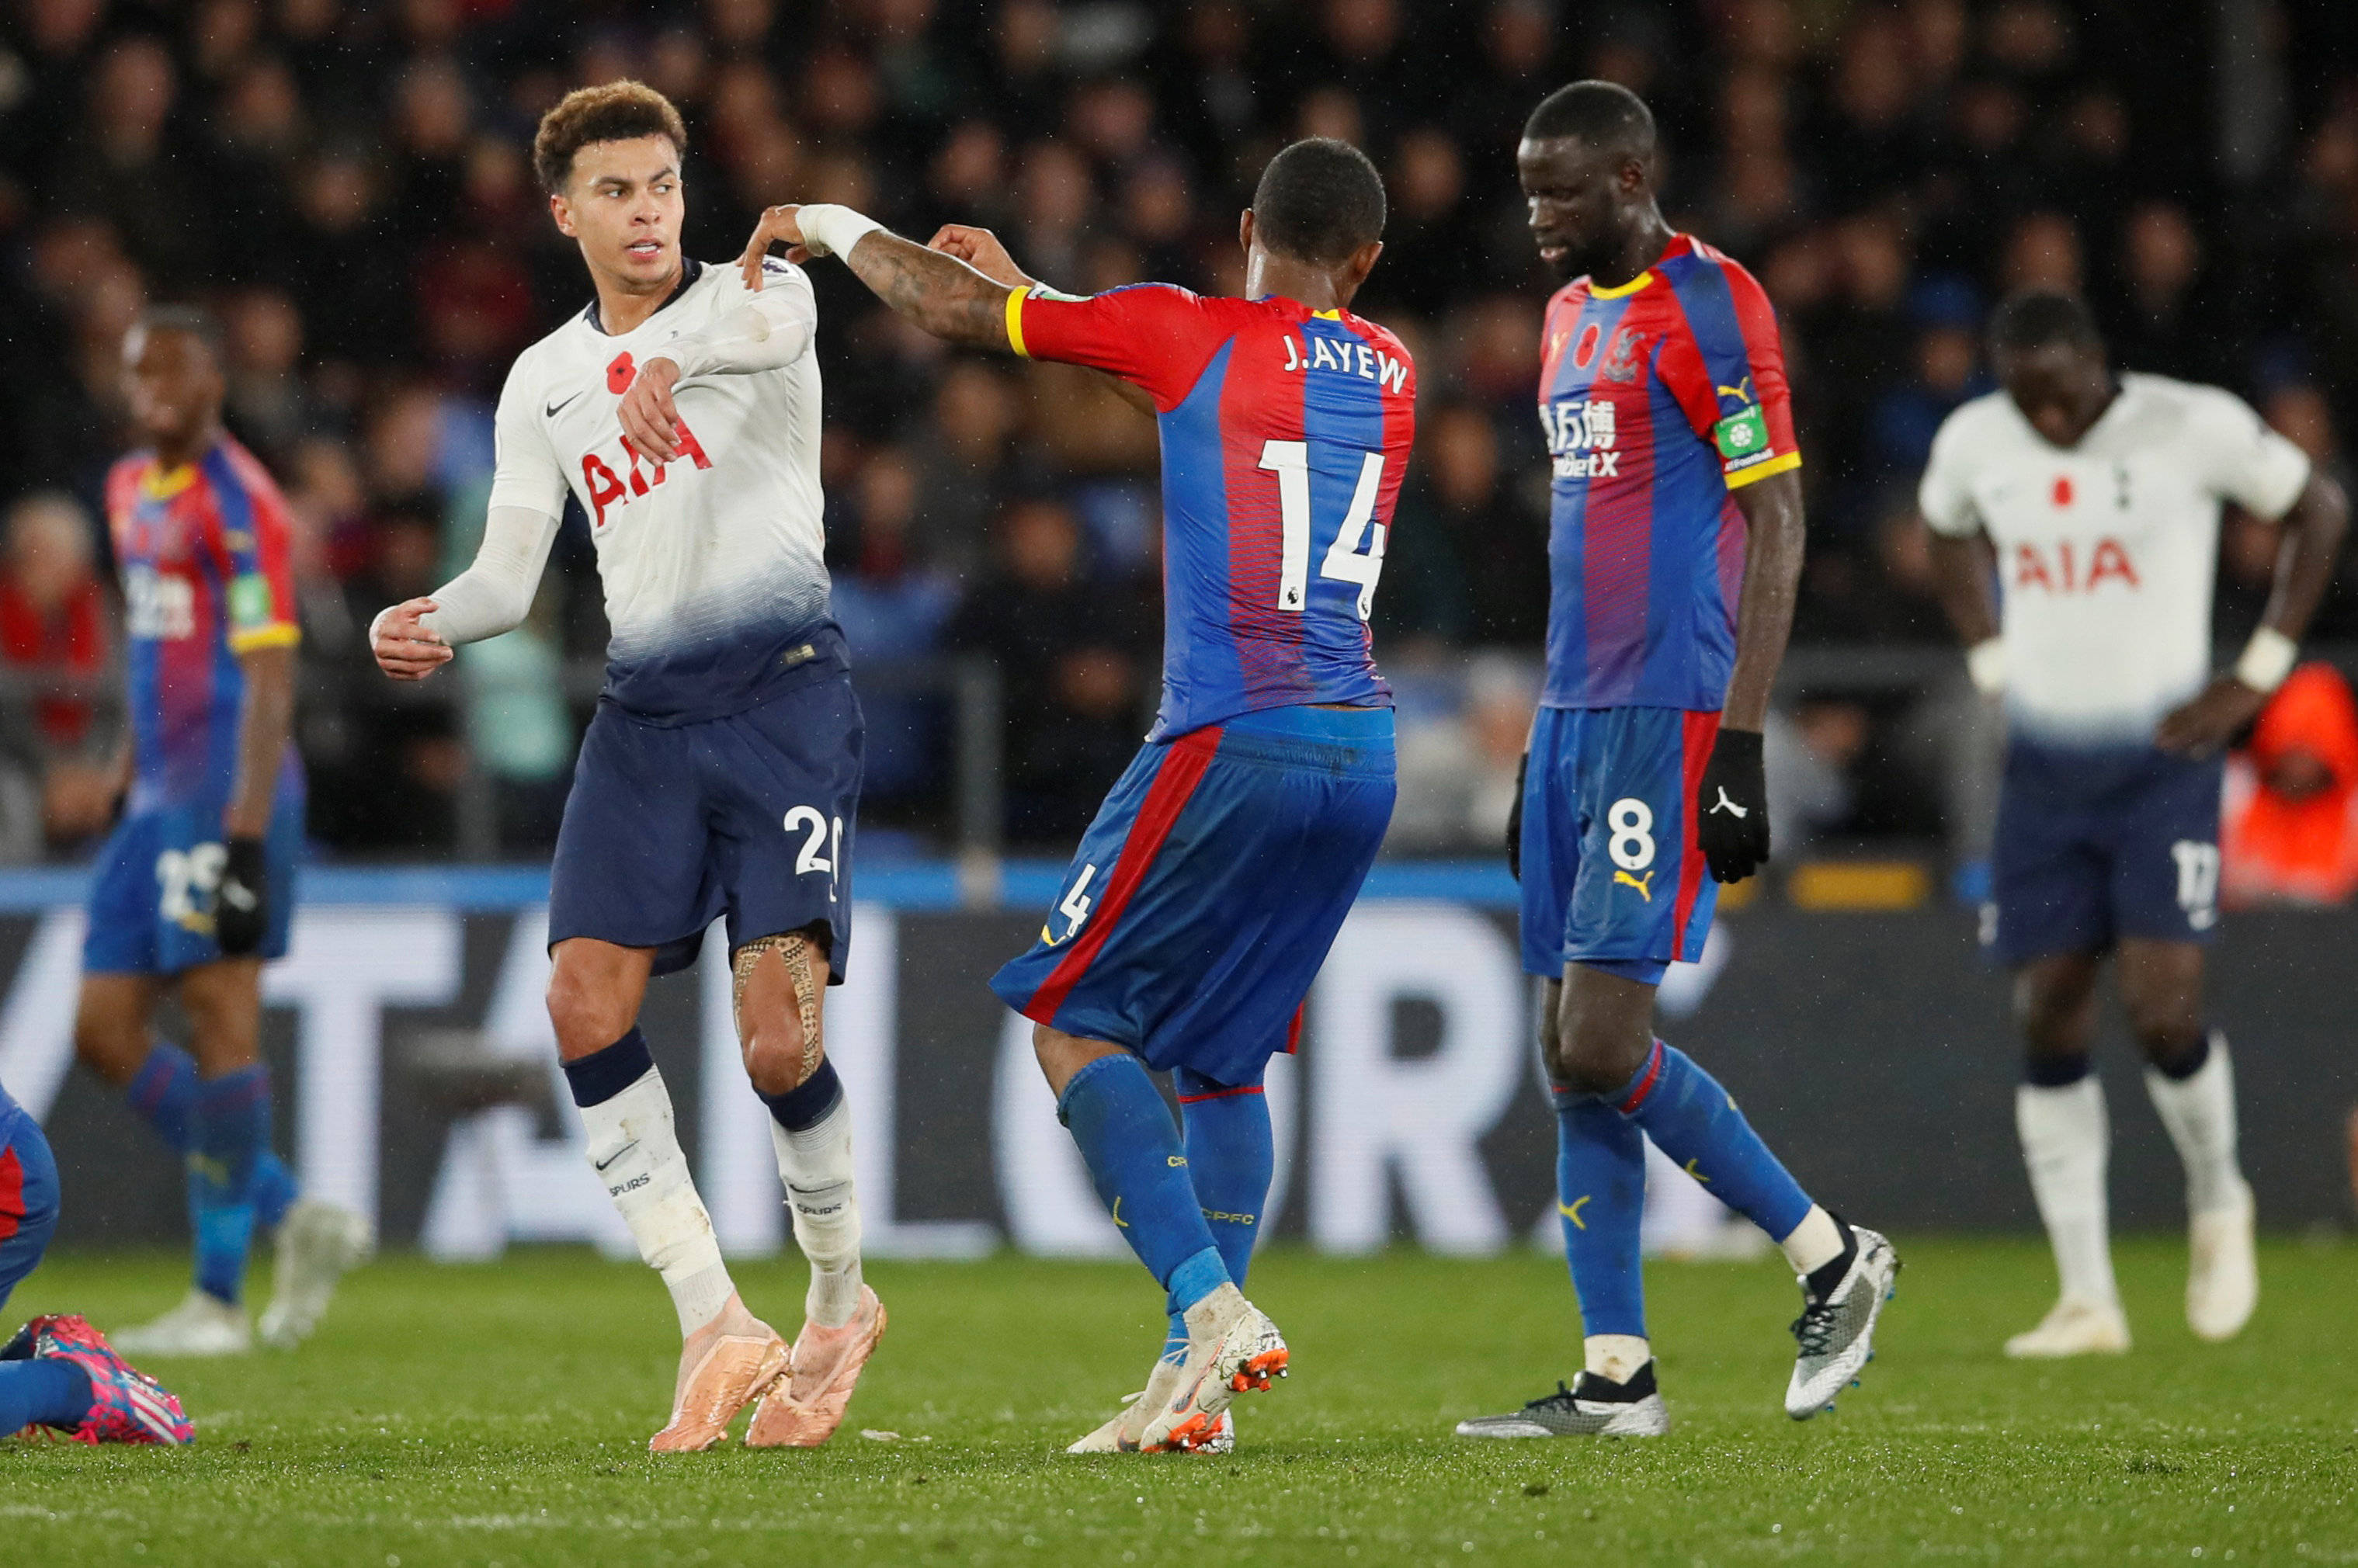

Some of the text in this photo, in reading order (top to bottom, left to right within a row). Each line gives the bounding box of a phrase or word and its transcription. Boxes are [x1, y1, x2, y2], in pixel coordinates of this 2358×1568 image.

[1283, 335, 1408, 395] J.AYEW
[1257, 439, 1386, 622] 14
[2016, 536, 2143, 593] AIA
[1607, 796, 1655, 871] 8
[1059, 862, 1096, 938] 4
[609, 1172, 651, 1197] SPURS
